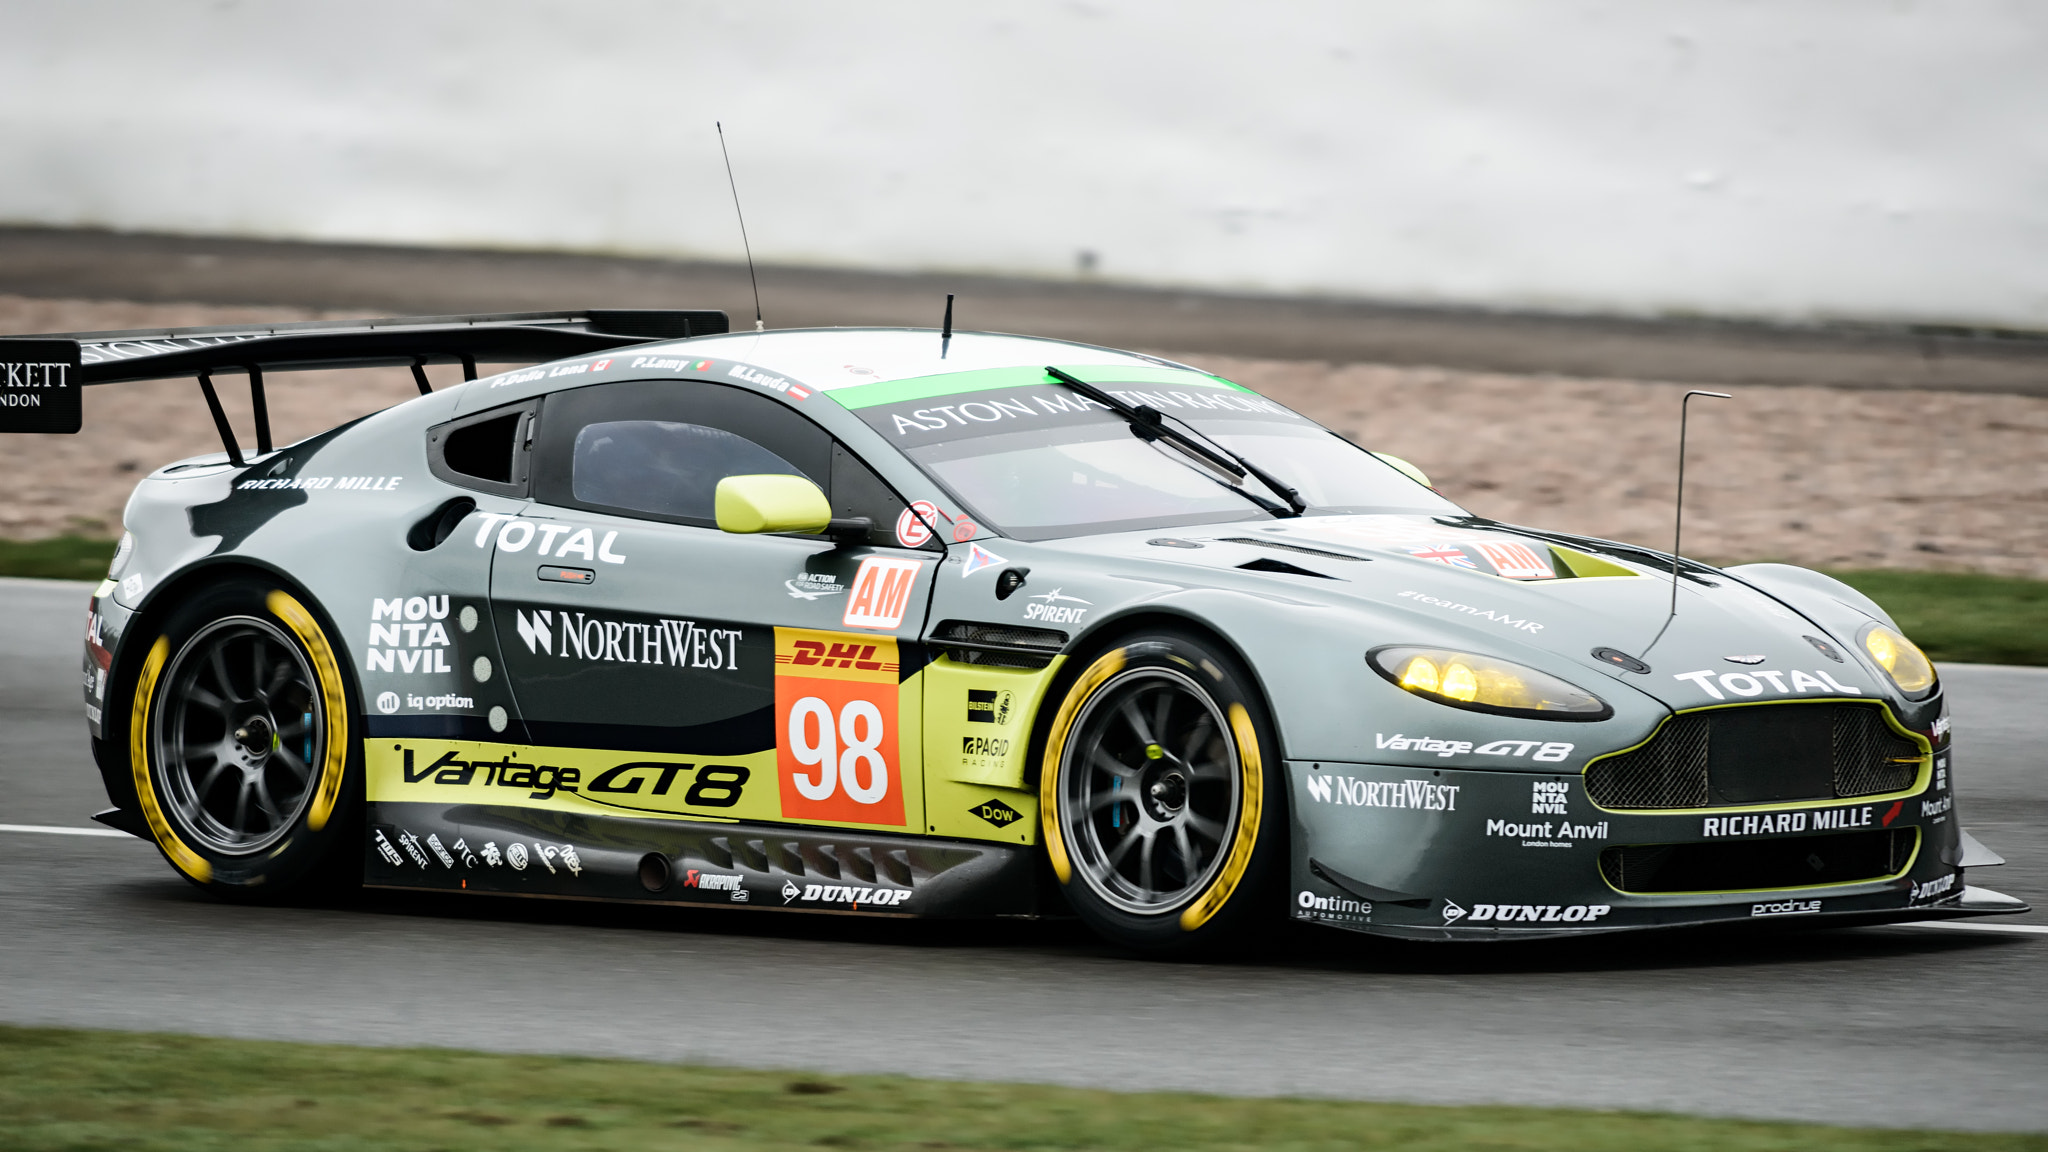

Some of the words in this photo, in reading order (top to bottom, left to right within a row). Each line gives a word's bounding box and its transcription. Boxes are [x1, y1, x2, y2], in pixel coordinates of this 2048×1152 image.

[631, 356, 690, 373] P.Lamy
[891, 397, 1039, 435] ASTON
[1031, 390, 1183, 414] MATIN
[237, 477, 334, 490] RICHARD
[333, 476, 403, 491] MILLE
[475, 512, 627, 565] TOTAL
[1477, 542, 1545, 570] AM
[808, 573, 837, 584] ACTION
[850, 566, 914, 619] AM
[371, 595, 450, 621] MOU
[1023, 602, 1087, 624] SPIRENT
[1396, 590, 1545, 634] #teamAMR
[369, 622, 451, 647] NTA
[366, 648, 452, 674] NVIL
[791, 639, 883, 671] DHL
[1673, 669, 1862, 700] TOTAL
[406, 693, 424, 710] iq
[426, 693, 474, 710] option
[788, 696, 889, 804] 98
[976, 737, 1009, 756] PAGID
[1376, 733, 1474, 758] Vantage
[1473, 739, 1575, 762] GT8
[403, 748, 581, 800] Vantage
[586, 761, 751, 808] GT8
[1532, 782, 1569, 793] MOU
[1531, 803, 1568, 814] NVIL
[1532, 793, 1568, 804] NTA
[1486, 818, 1553, 838] Mount
[1557, 821, 1609, 839] Anvil
[1703, 812, 1807, 837] RICHARD
[1813, 806, 1873, 831] MILLE
[399, 834, 429, 870] SPIRENT
[801, 884, 913, 906] DUNLOP
[1298, 890, 1373, 914] Ontime
[1297, 910, 1372, 923] AUTOMOTIVE
[1467, 904, 1611, 922] DUNLOP
[1751, 899, 1822, 917] prodrive
